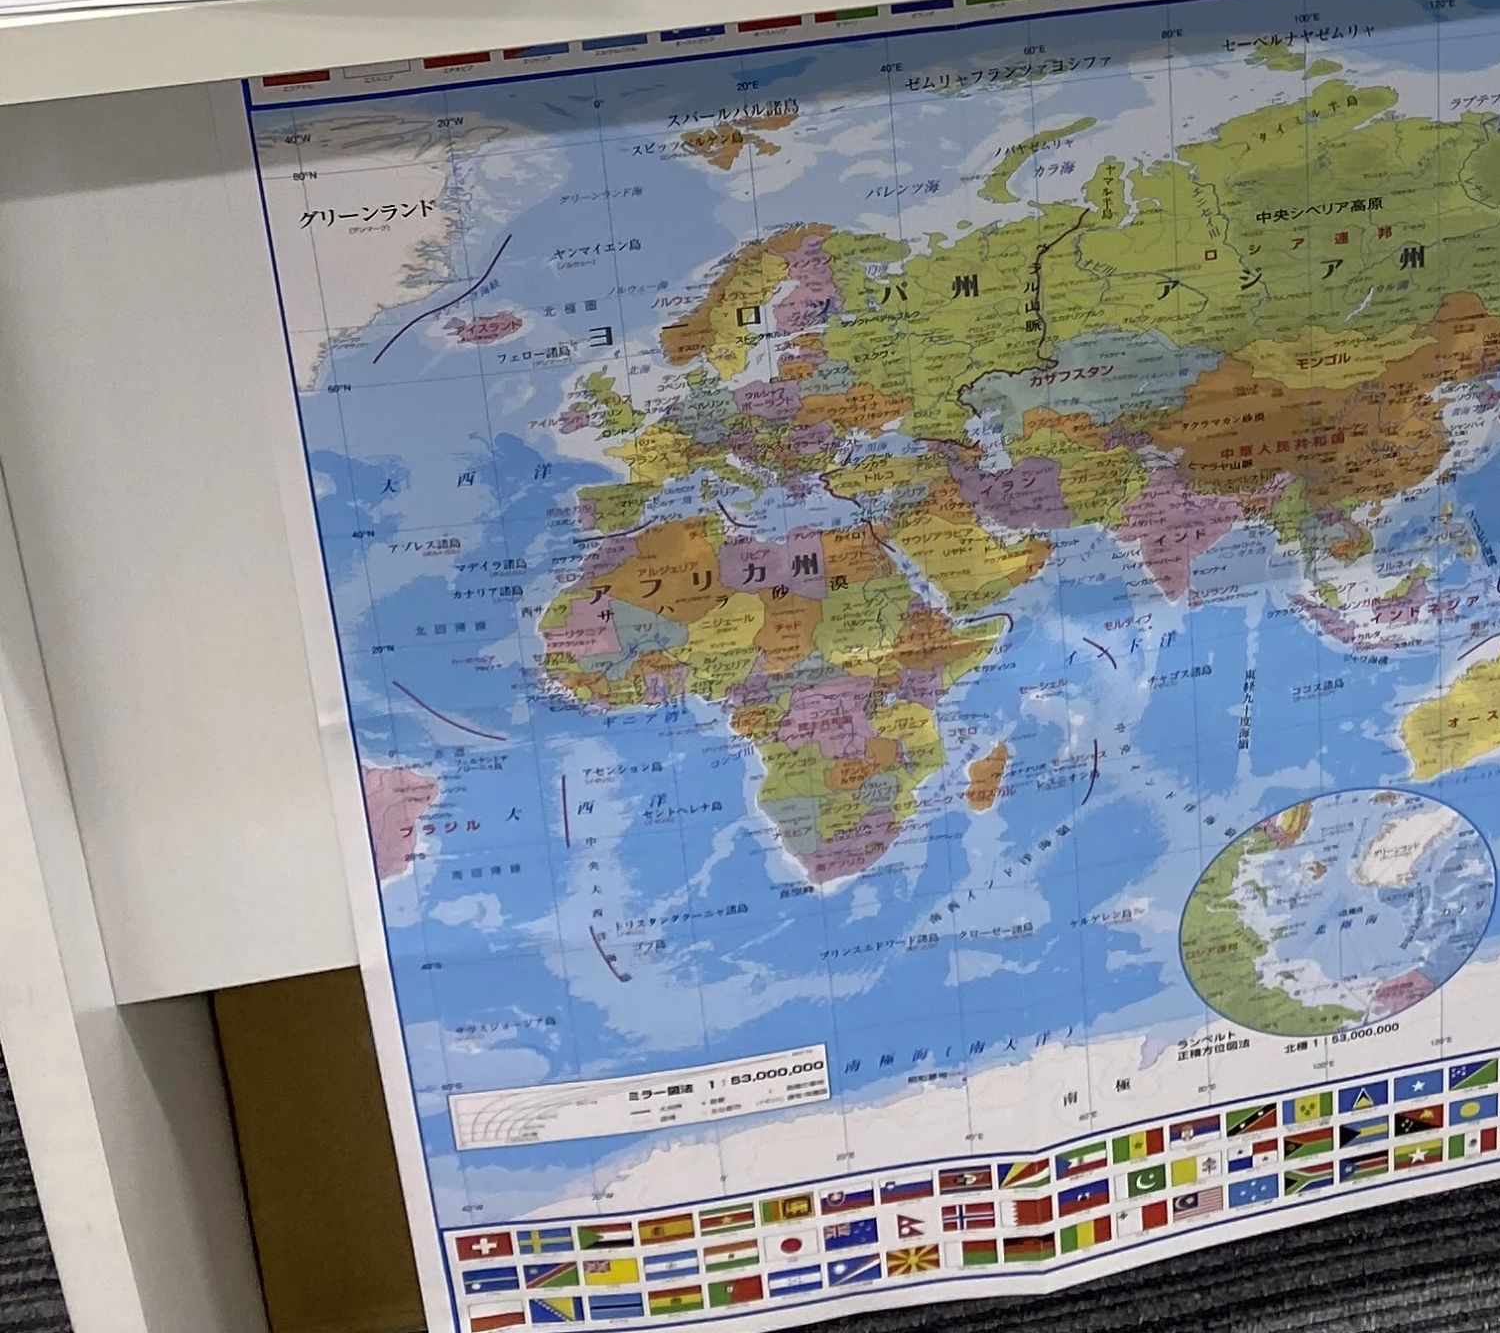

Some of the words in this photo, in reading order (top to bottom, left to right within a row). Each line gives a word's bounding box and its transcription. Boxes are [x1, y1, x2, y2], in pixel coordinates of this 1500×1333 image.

[300, 198, 438, 231] グリーンランド
[1255, 196, 1385, 226] 中央シベリア高原
